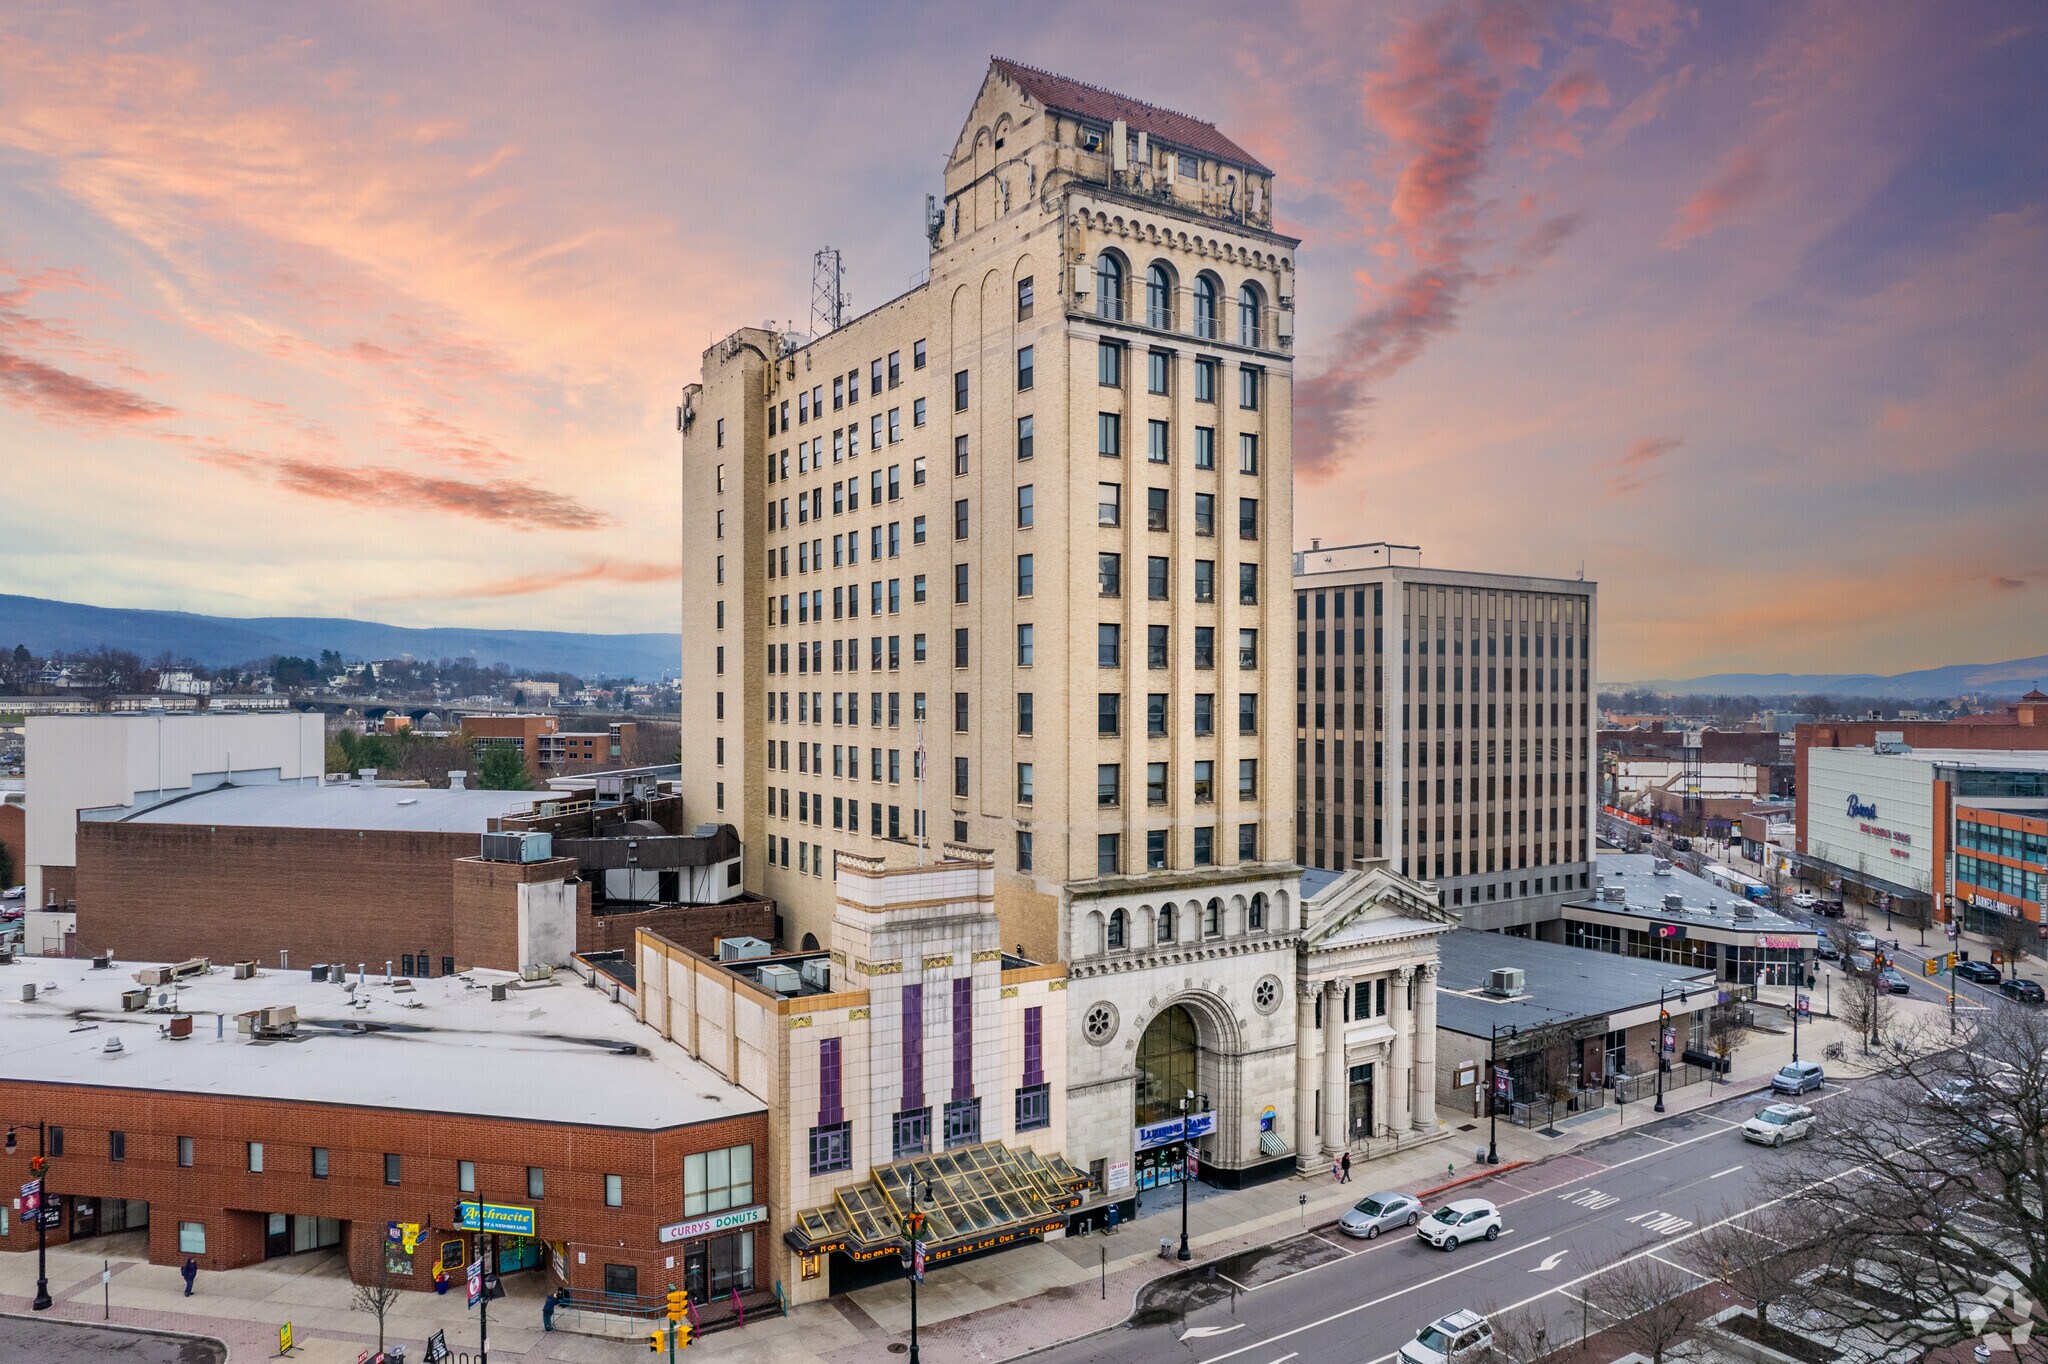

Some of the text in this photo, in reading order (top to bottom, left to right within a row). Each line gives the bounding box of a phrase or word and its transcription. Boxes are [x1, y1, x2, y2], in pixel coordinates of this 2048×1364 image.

[1140, 1116, 1212, 1141] LUZERNE BANK
[1557, 1187, 1621, 1210] ONLY
[463, 1206, 530, 1223] Anthracite
[495, 1222, 528, 1231] NEWSSTAND
[671, 1211, 758, 1238] CURRYS DONUTS
[1624, 1210, 1693, 1235] ONLY
[935, 1251, 952, 1260] Get
[957, 1244, 974, 1254] the
[978, 1238, 995, 1249] Led
[1000, 1234, 1015, 1243] Out
[1029, 1221, 1064, 1235] Friday,
